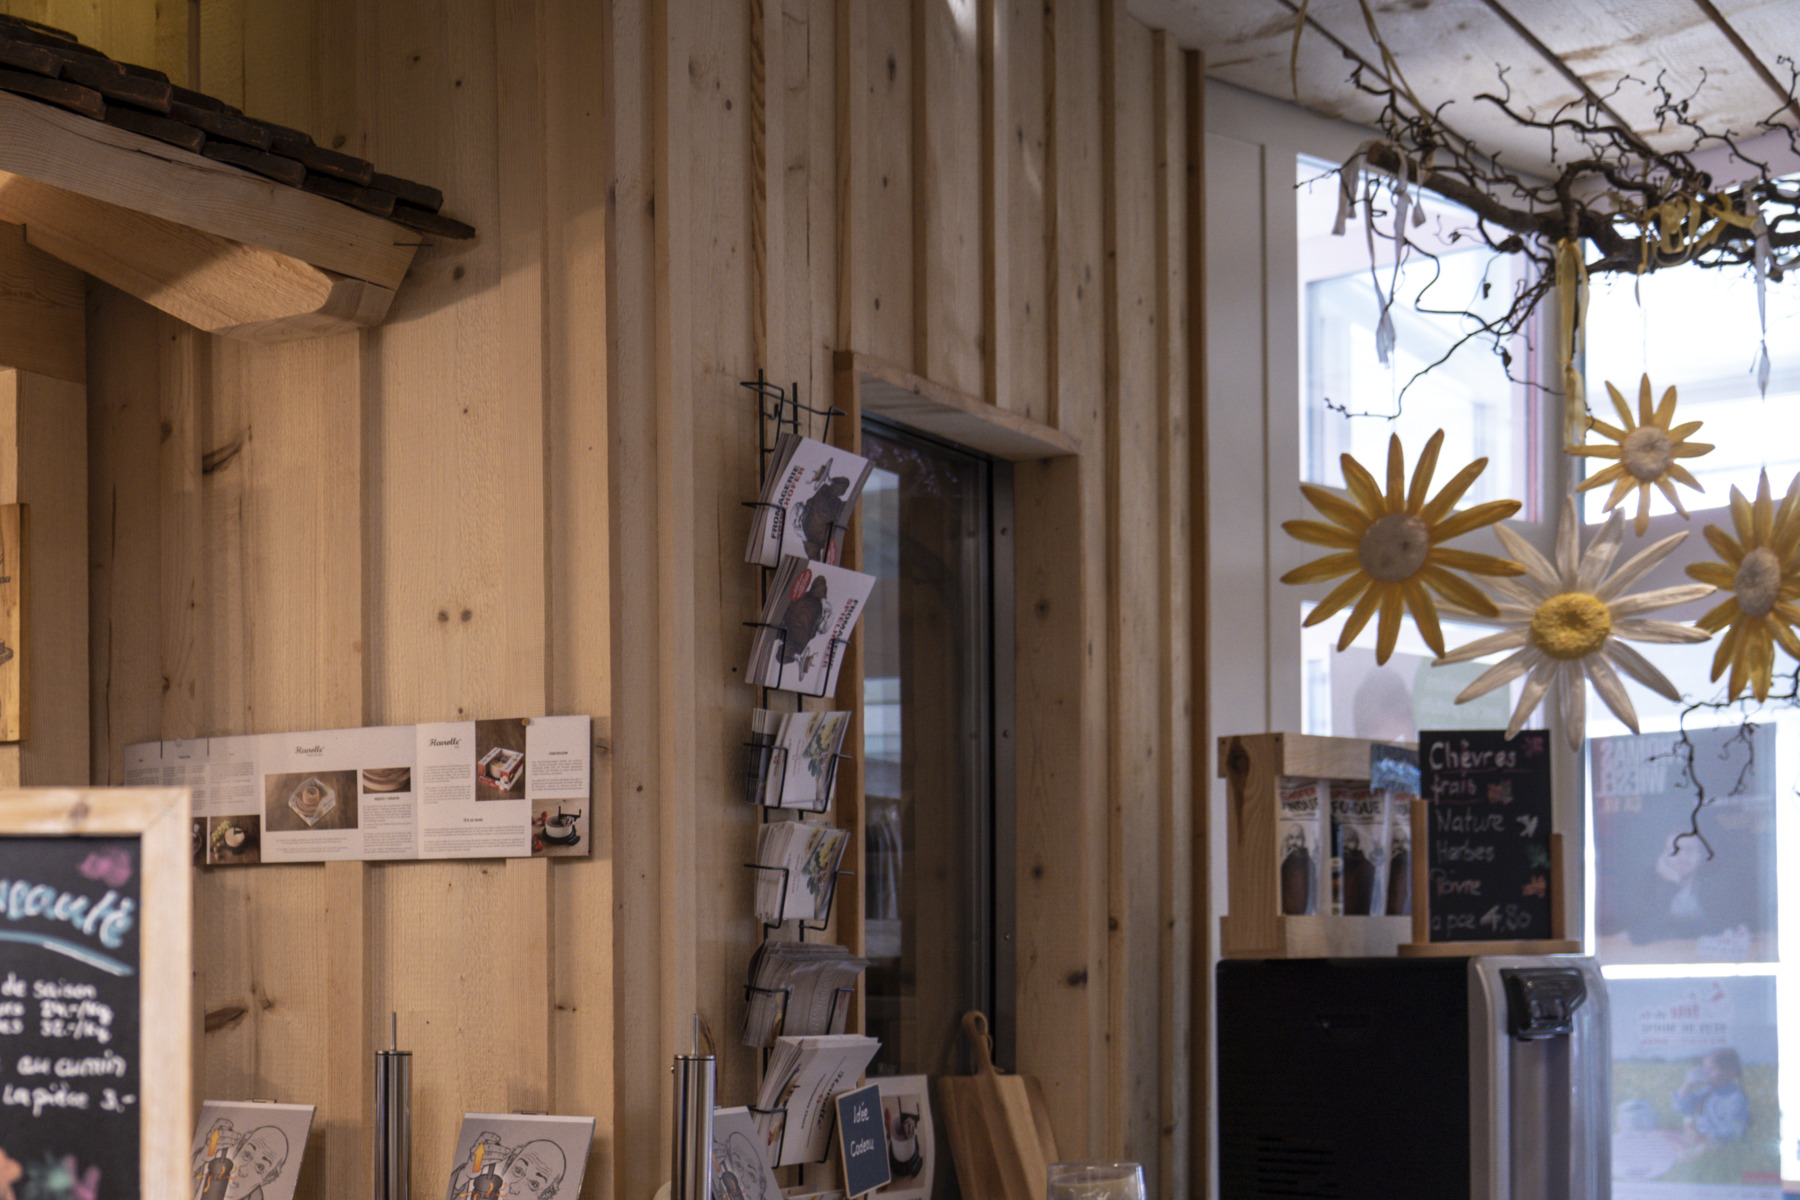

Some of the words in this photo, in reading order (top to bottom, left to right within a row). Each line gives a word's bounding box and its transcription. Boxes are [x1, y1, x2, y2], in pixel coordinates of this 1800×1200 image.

[1, 971, 27, 998] de
[33, 978, 97, 1000] saison
[16, 1054, 50, 1076] au
[54, 1048, 127, 1078] cumin
[853, 1101, 869, 1124] Idée
